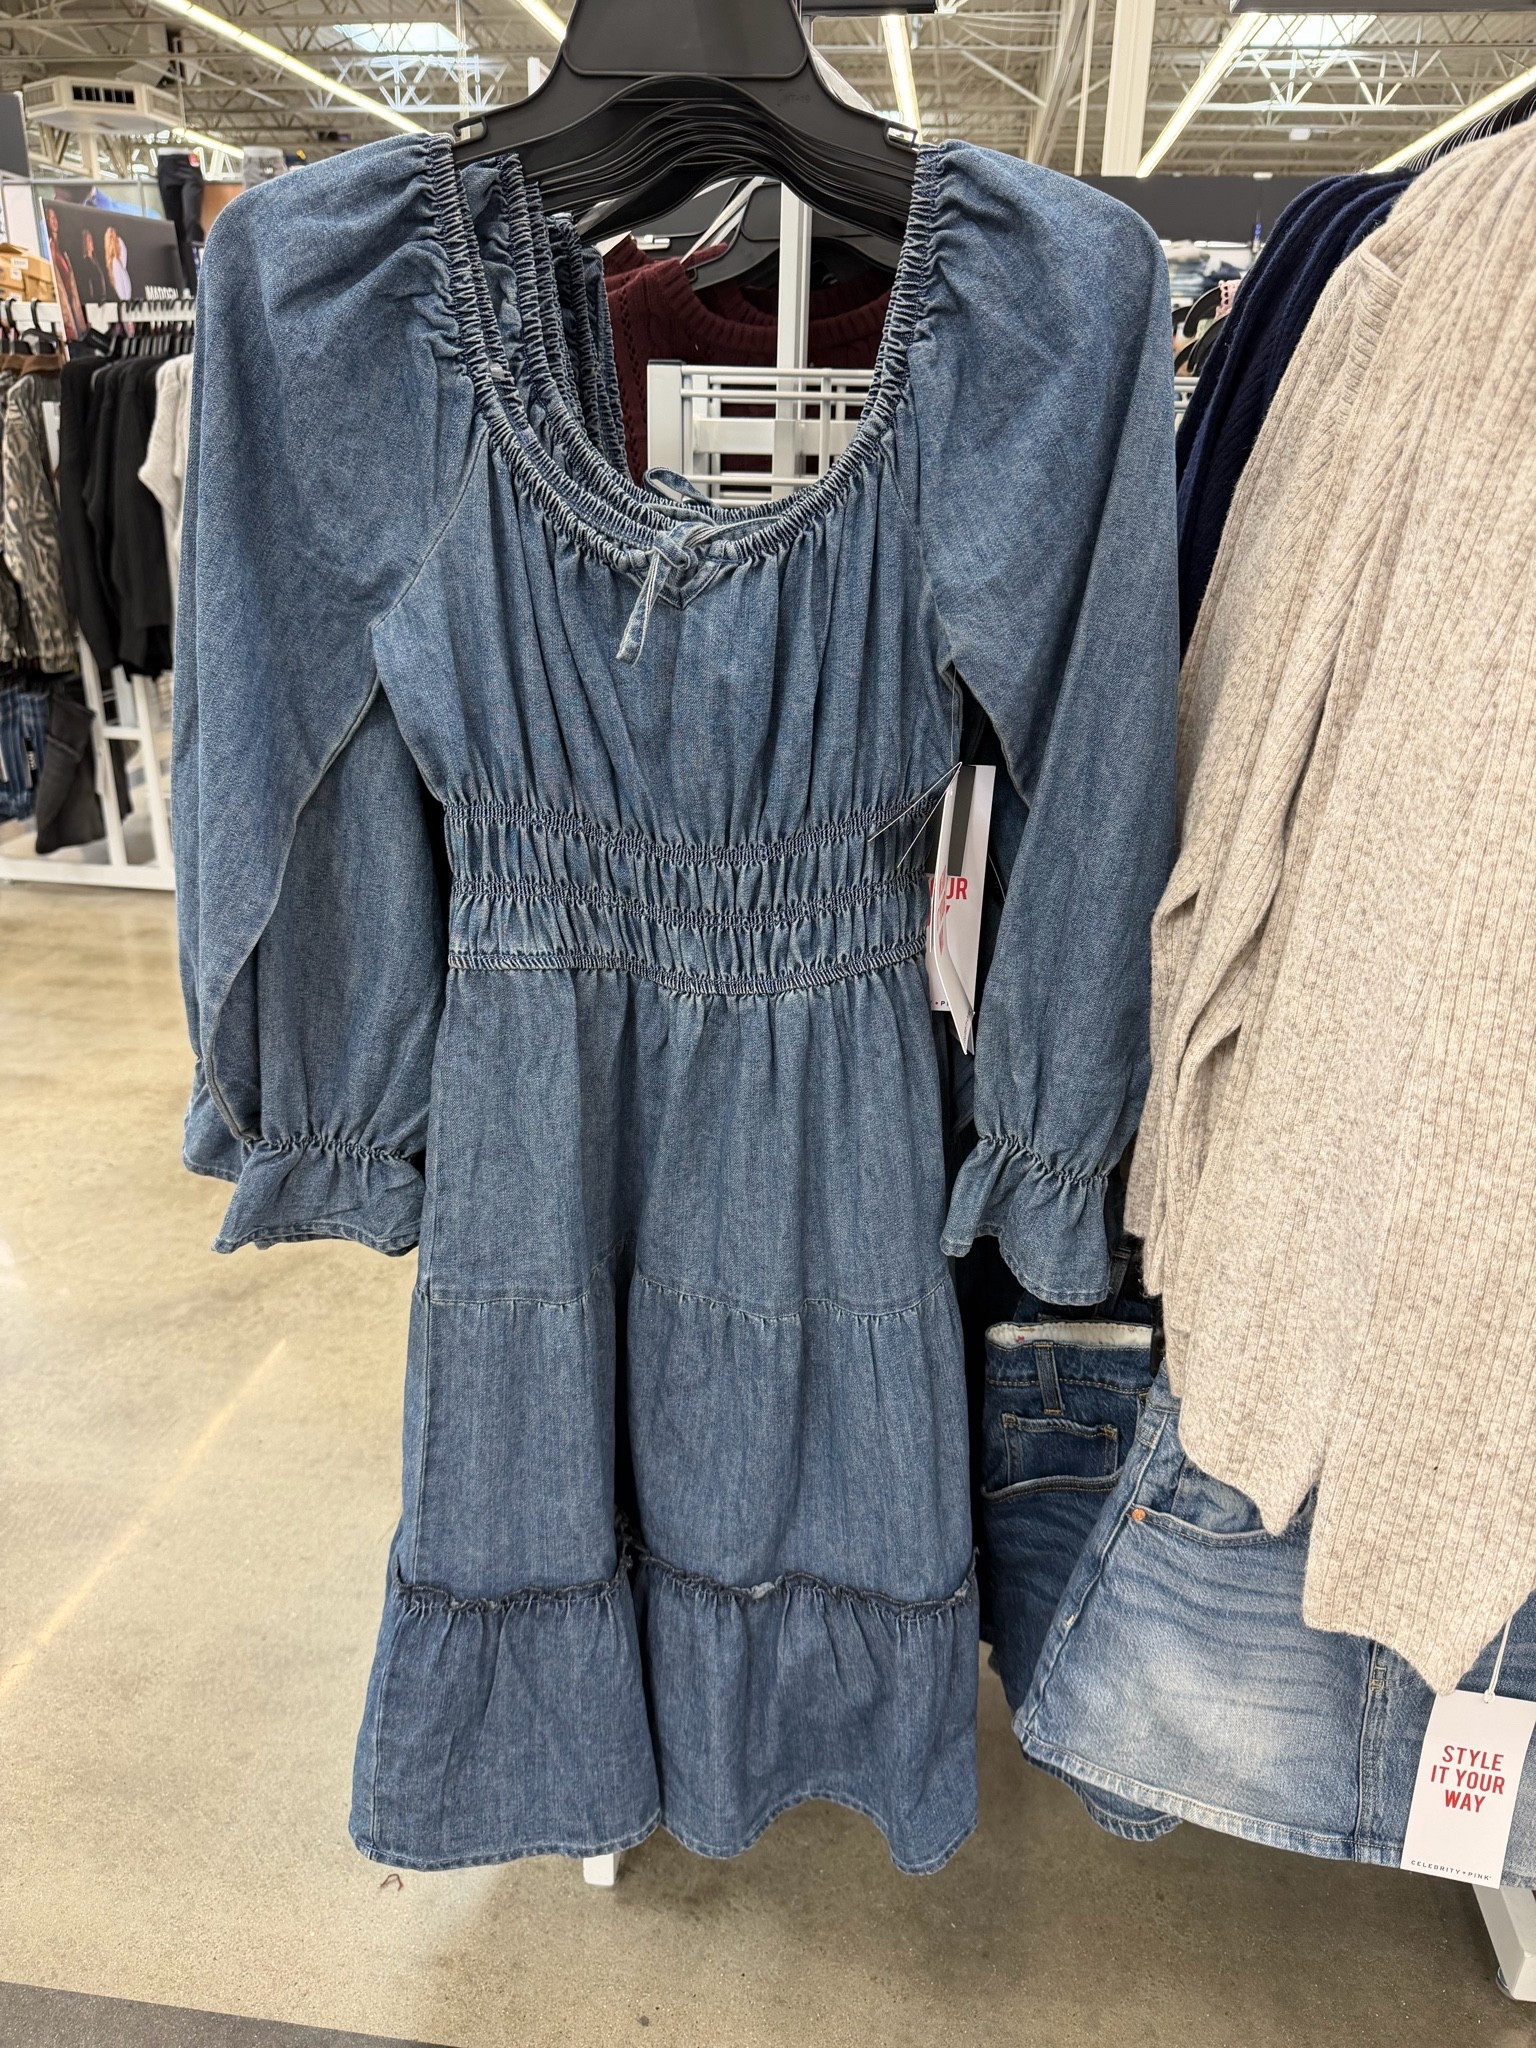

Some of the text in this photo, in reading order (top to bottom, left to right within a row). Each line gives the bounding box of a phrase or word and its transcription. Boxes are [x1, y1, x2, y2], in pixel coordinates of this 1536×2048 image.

[1442, 1745, 1504, 1771] STYLE
[1430, 1765, 1505, 1794] IT YOUR
[1445, 1789, 1486, 1813] WAY
[1411, 1860, 1489, 1881] CELEBRITY PINK
